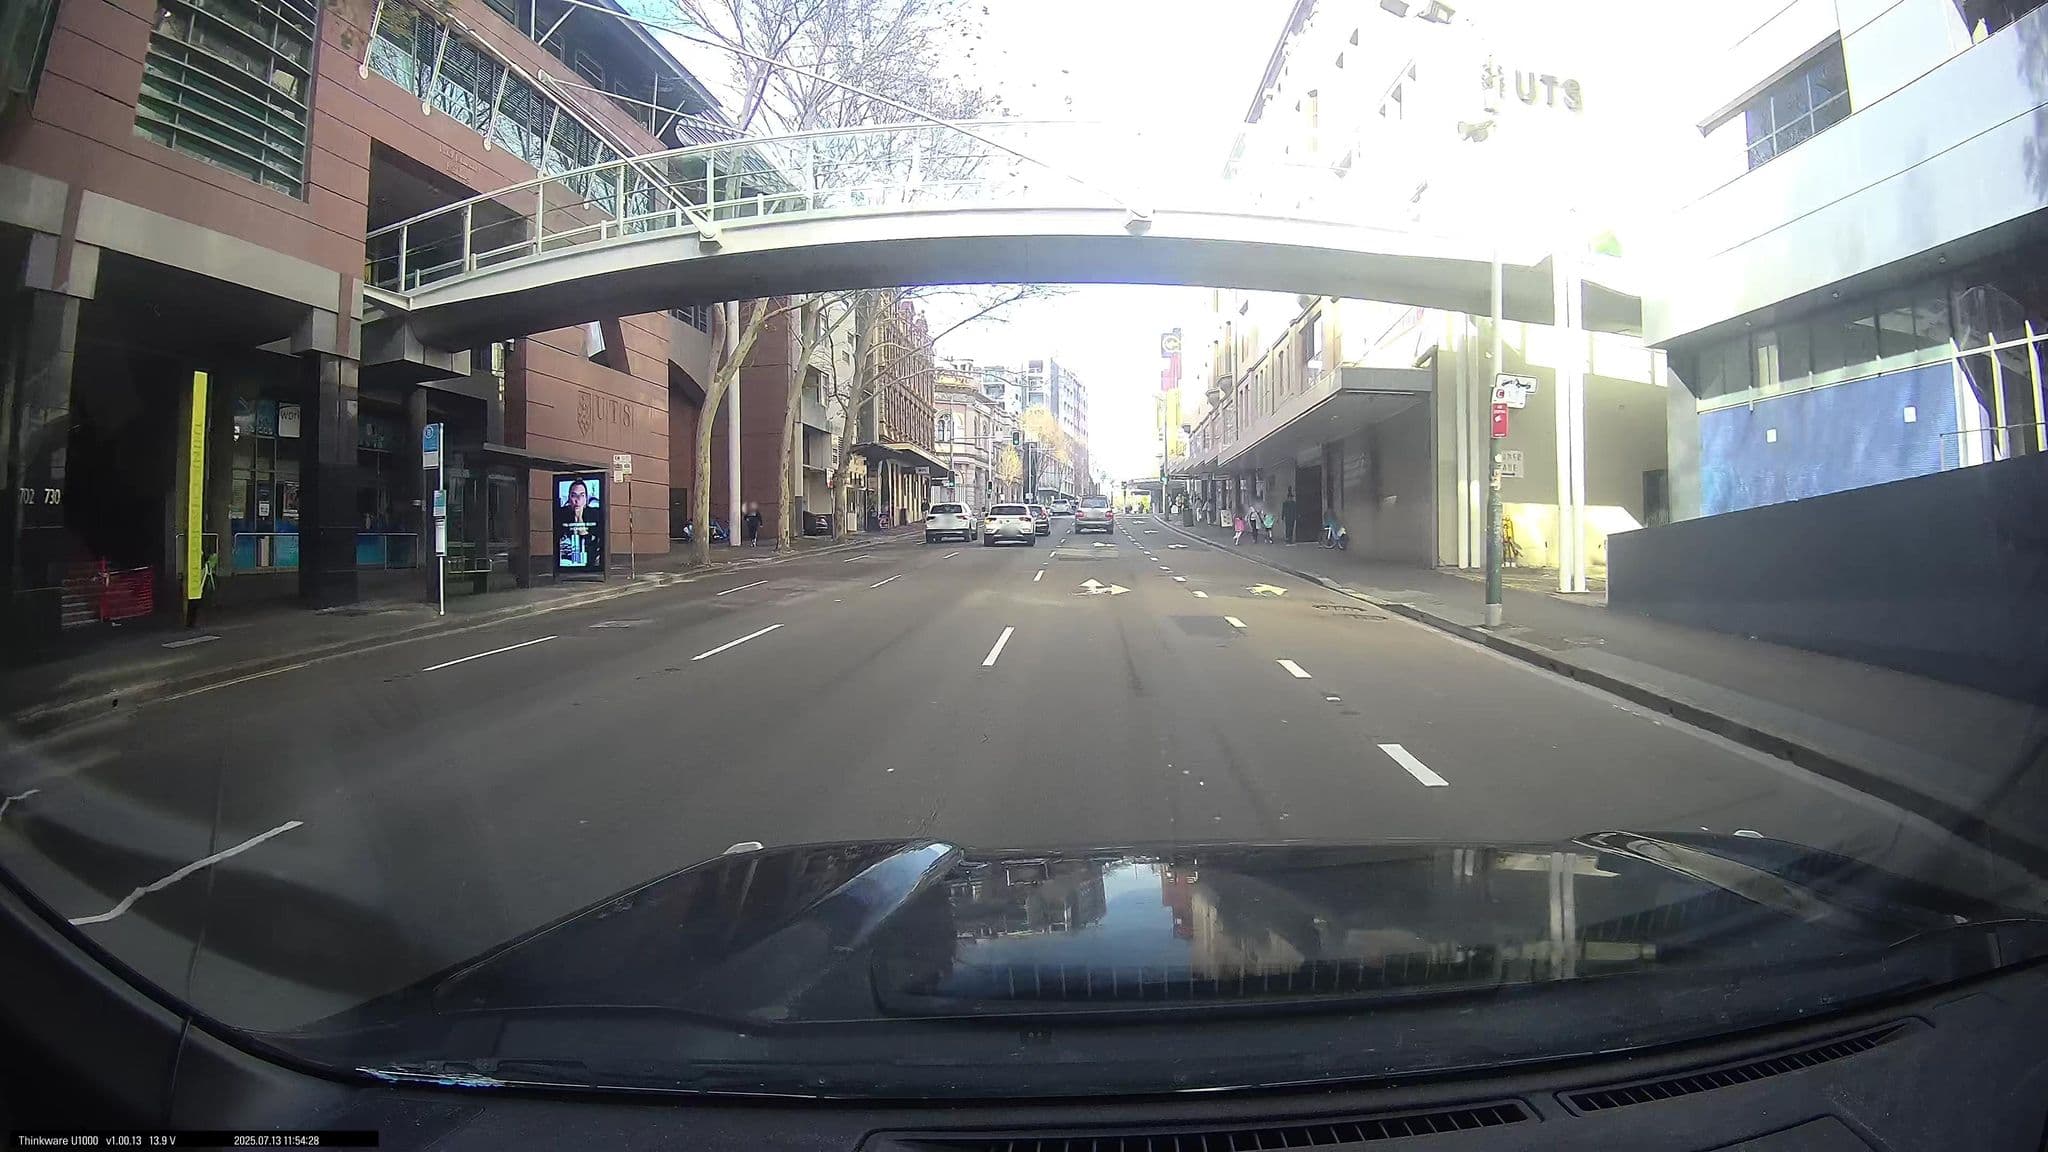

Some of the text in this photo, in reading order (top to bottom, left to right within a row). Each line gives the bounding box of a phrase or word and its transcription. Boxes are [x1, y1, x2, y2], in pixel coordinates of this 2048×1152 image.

[1515, 69, 1582, 112] UTS
[595, 394, 631, 427] UTS
[19, 487, 61, 504] 702 730
